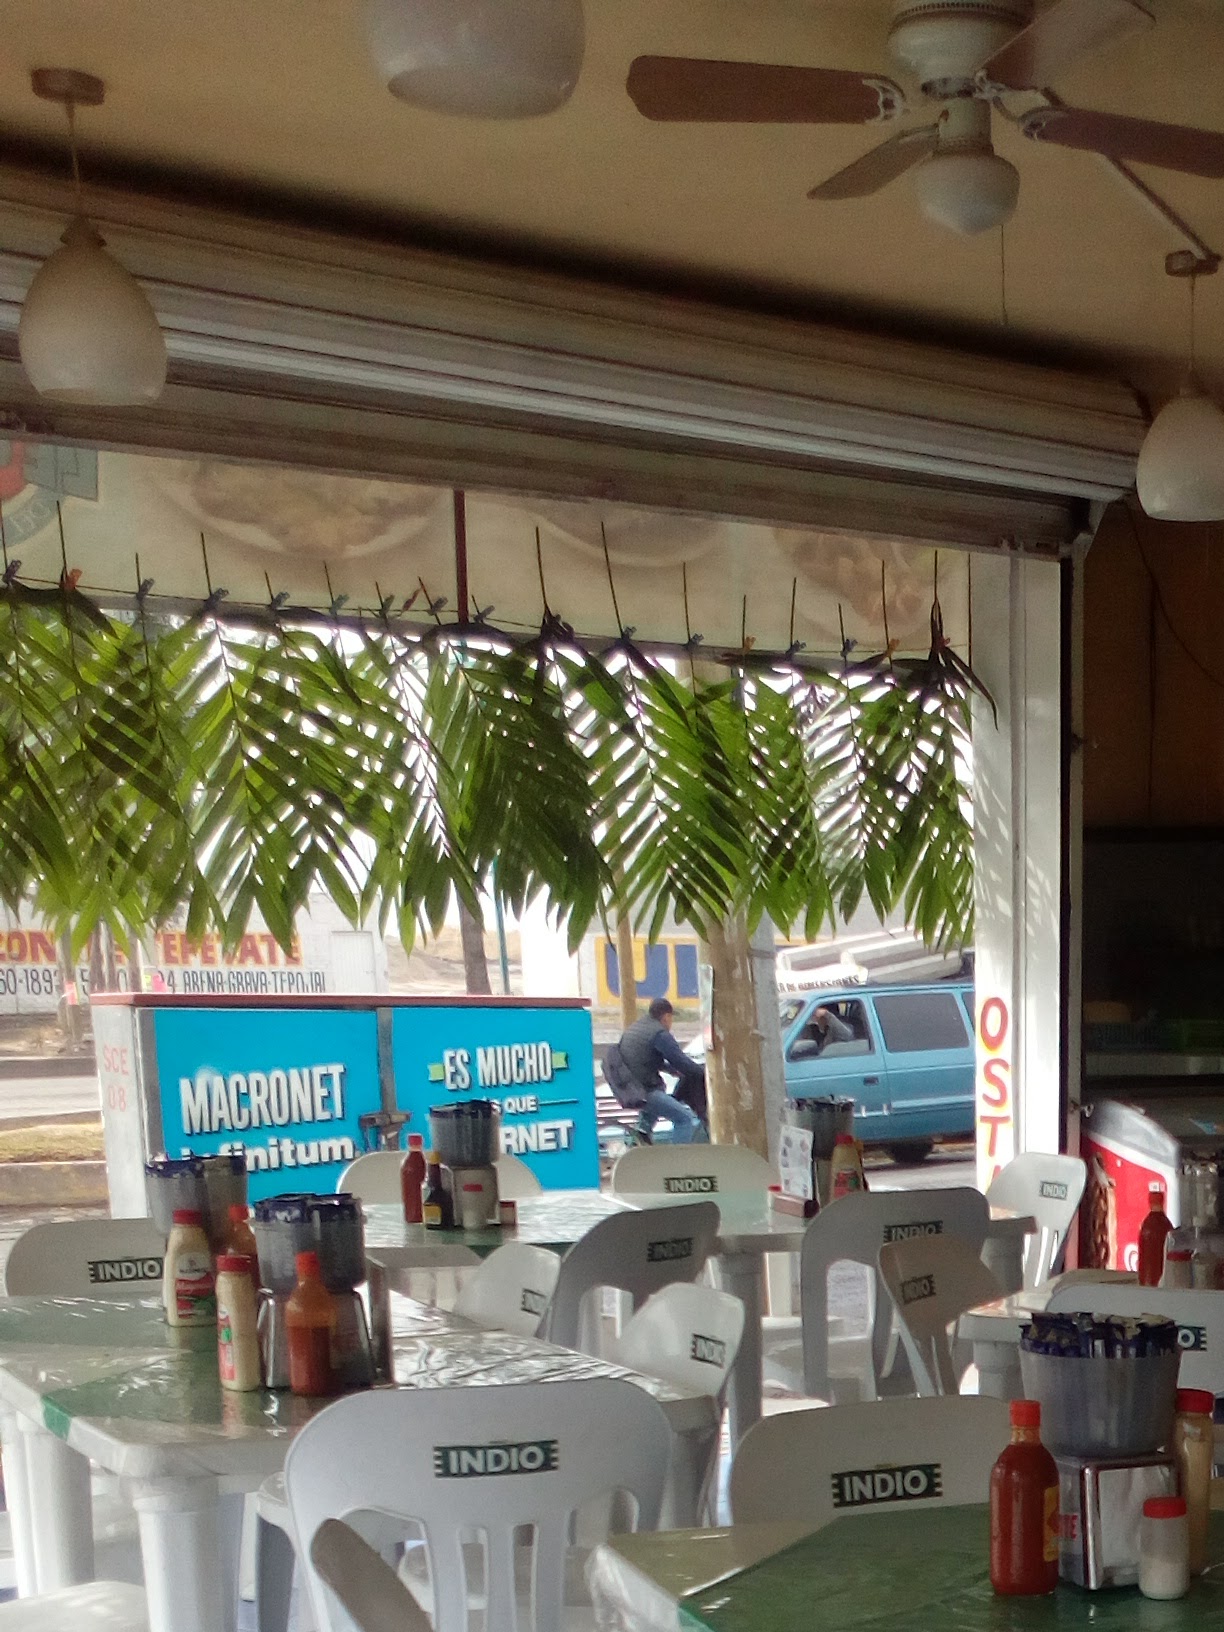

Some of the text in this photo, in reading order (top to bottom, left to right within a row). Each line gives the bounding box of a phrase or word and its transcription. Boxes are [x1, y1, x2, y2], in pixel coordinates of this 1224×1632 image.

[103, 1046, 129, 1076] SCE
[443, 1041, 553, 1091] ES MUCHO
[178, 1063, 346, 1136] MACRONET
[503, 1096, 539, 1114] QUE
[670, 1178, 712, 1192] INDIO
[97, 1260, 161, 1281] INDIO
[448, 1445, 545, 1474] INDIO
[843, 1469, 928, 1502] INDIO
